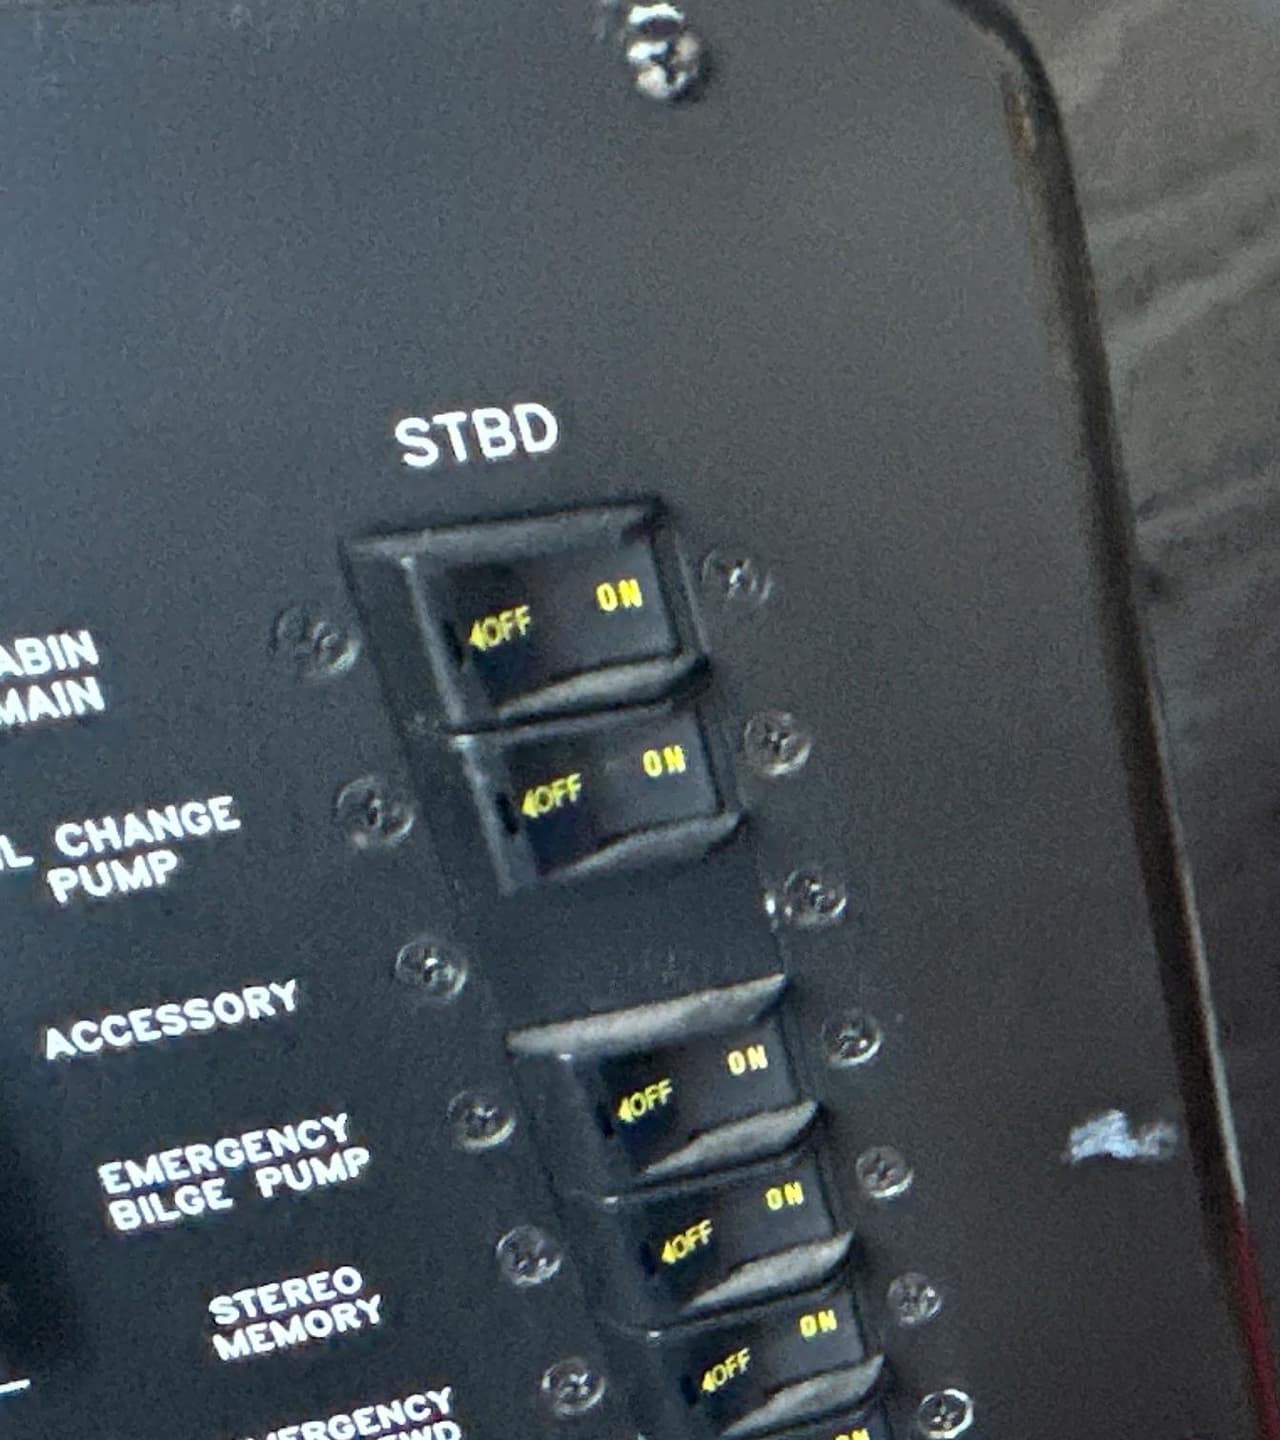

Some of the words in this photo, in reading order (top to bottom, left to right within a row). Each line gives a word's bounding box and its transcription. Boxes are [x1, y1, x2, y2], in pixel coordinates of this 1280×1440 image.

[394, 402, 559, 469] STBD
[595, 578, 641, 610] ON
[0, 676, 105, 726] MAIN
[642, 745, 684, 774] ON
[54, 795, 241, 858] CHANGE
[46, 849, 178, 904] PUMP
[46, 979, 296, 1060] ACCESSORY
[727, 1046, 764, 1071] ON
[97, 1112, 348, 1195] EMERGENCY
[108, 1177, 234, 1231] BILGE
[255, 1147, 370, 1198] PUMP
[765, 1182, 803, 1207] ON
[208, 1266, 365, 1325] STEREO
[799, 1310, 836, 1335] ON
[212, 1294, 381, 1361] MEMORY
